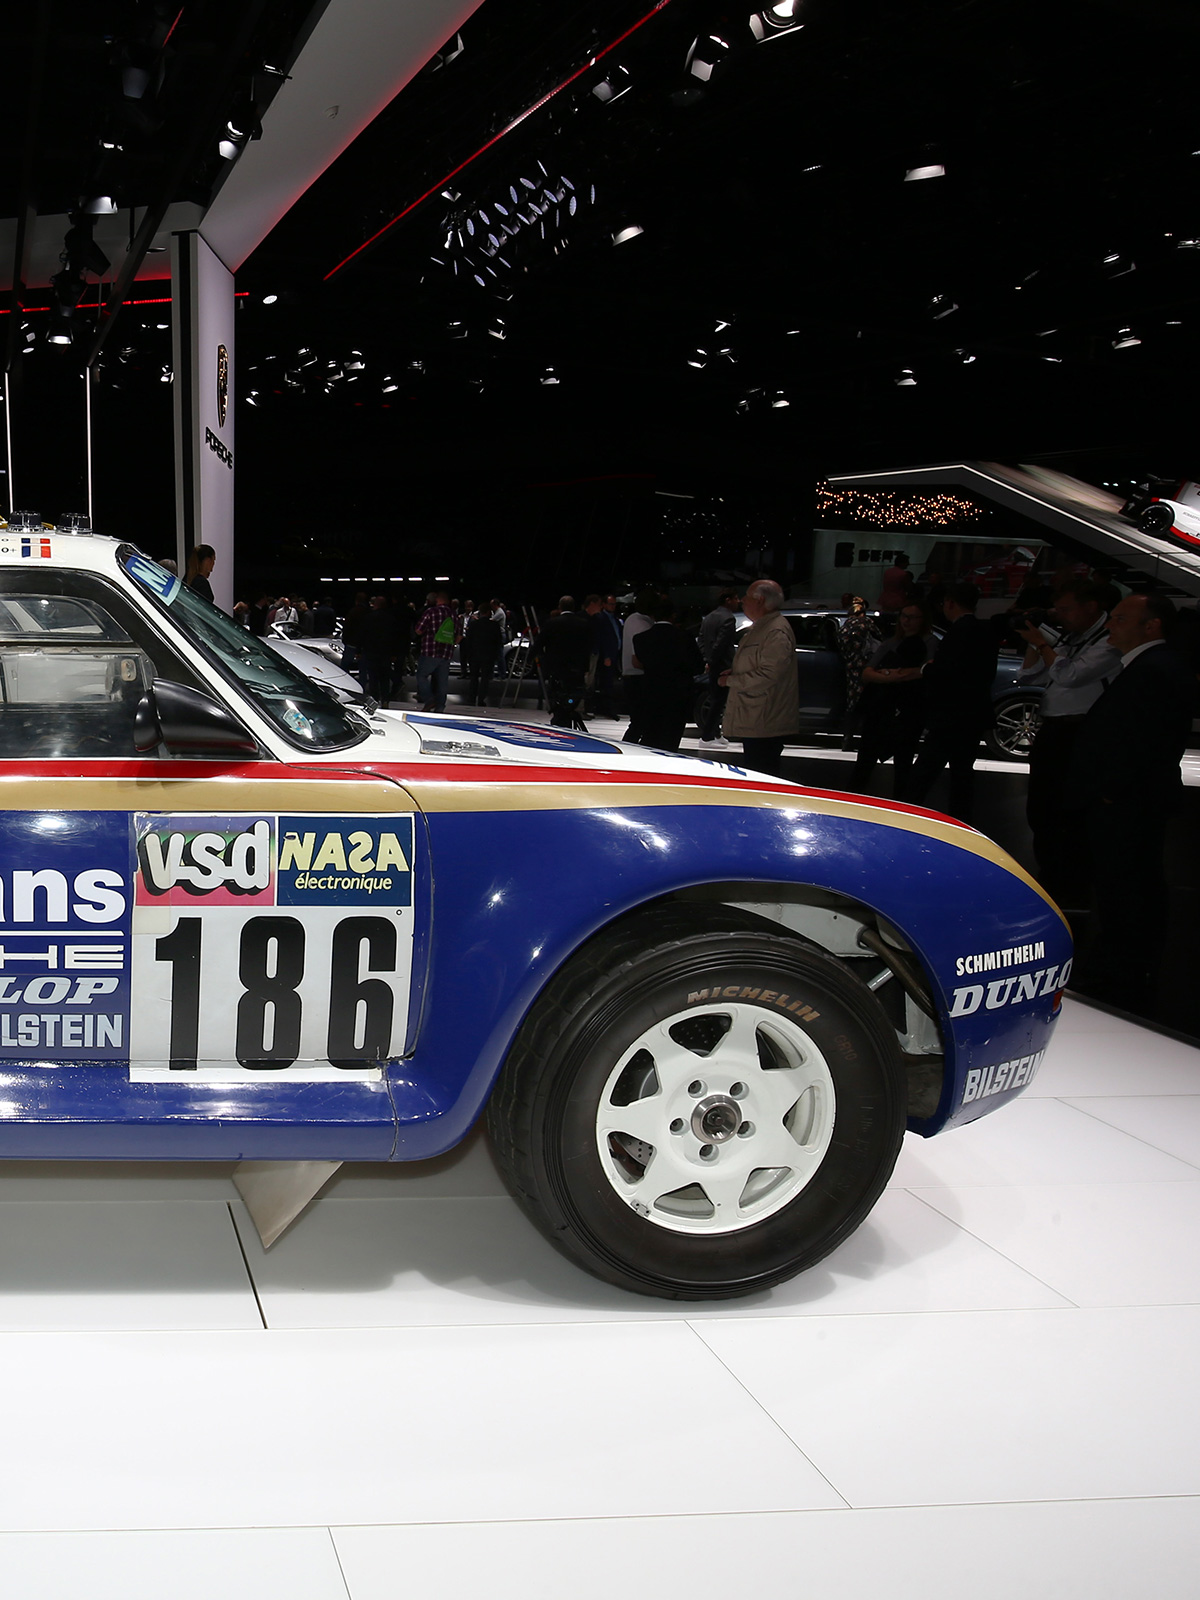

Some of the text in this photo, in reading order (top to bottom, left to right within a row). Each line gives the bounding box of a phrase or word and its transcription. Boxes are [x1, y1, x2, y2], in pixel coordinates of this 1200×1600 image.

[138, 820, 270, 895] vsd
[295, 872, 392, 894] électronique
[956, 941, 1045, 976] SCHMITTHELM
[155, 915, 398, 1071] 186
[687, 985, 821, 1022] MICHELIN
